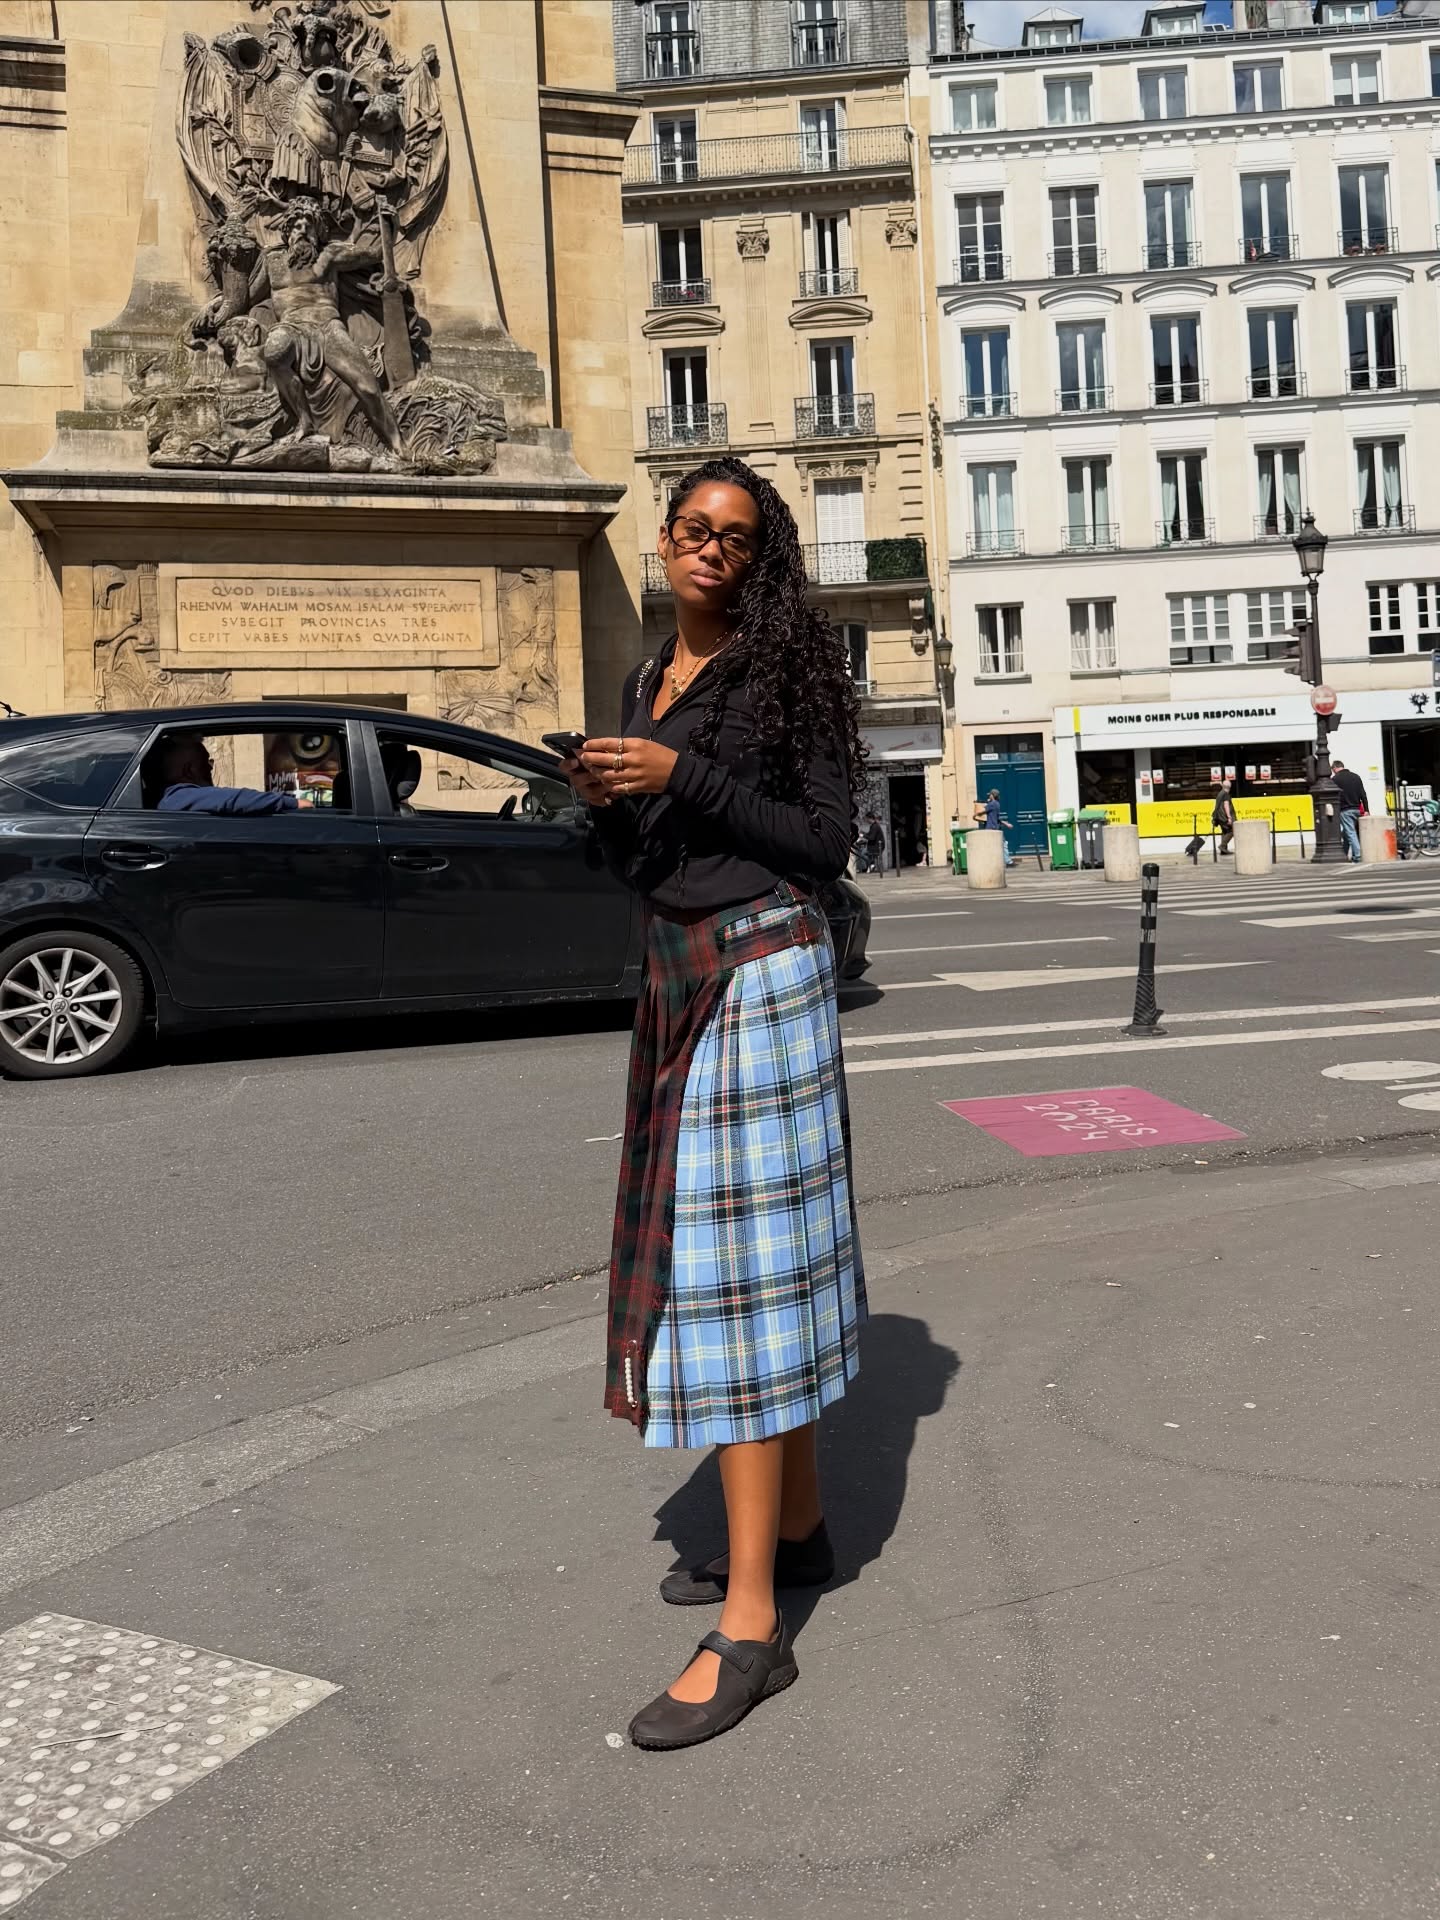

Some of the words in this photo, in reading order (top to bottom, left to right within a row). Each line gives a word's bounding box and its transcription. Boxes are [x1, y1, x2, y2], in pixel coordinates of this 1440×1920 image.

[211, 586, 254, 597] QVOD
[364, 587, 447, 598] SEXAGINTA
[180, 601, 233, 612] RHENVM
[240, 601, 298, 612] WAHALIM
[305, 602, 351, 612] MOSAM
[221, 616, 285, 628] SVBEGIT
[401, 617, 438, 628] TRES
[188, 632, 231, 643] CEPIT
[243, 632, 289, 643] VRBES
[299, 632, 361, 643] MVNITAS
[372, 632, 473, 643] QVADRAGINTA
[1107, 714, 1142, 725] MOINS
[1144, 713, 1171, 723] CHER
[1174, 711, 1200, 721] PLUS
[1203, 707, 1277, 720] RESPONSABLE
[1022, 1103, 1109, 1140] 2024
